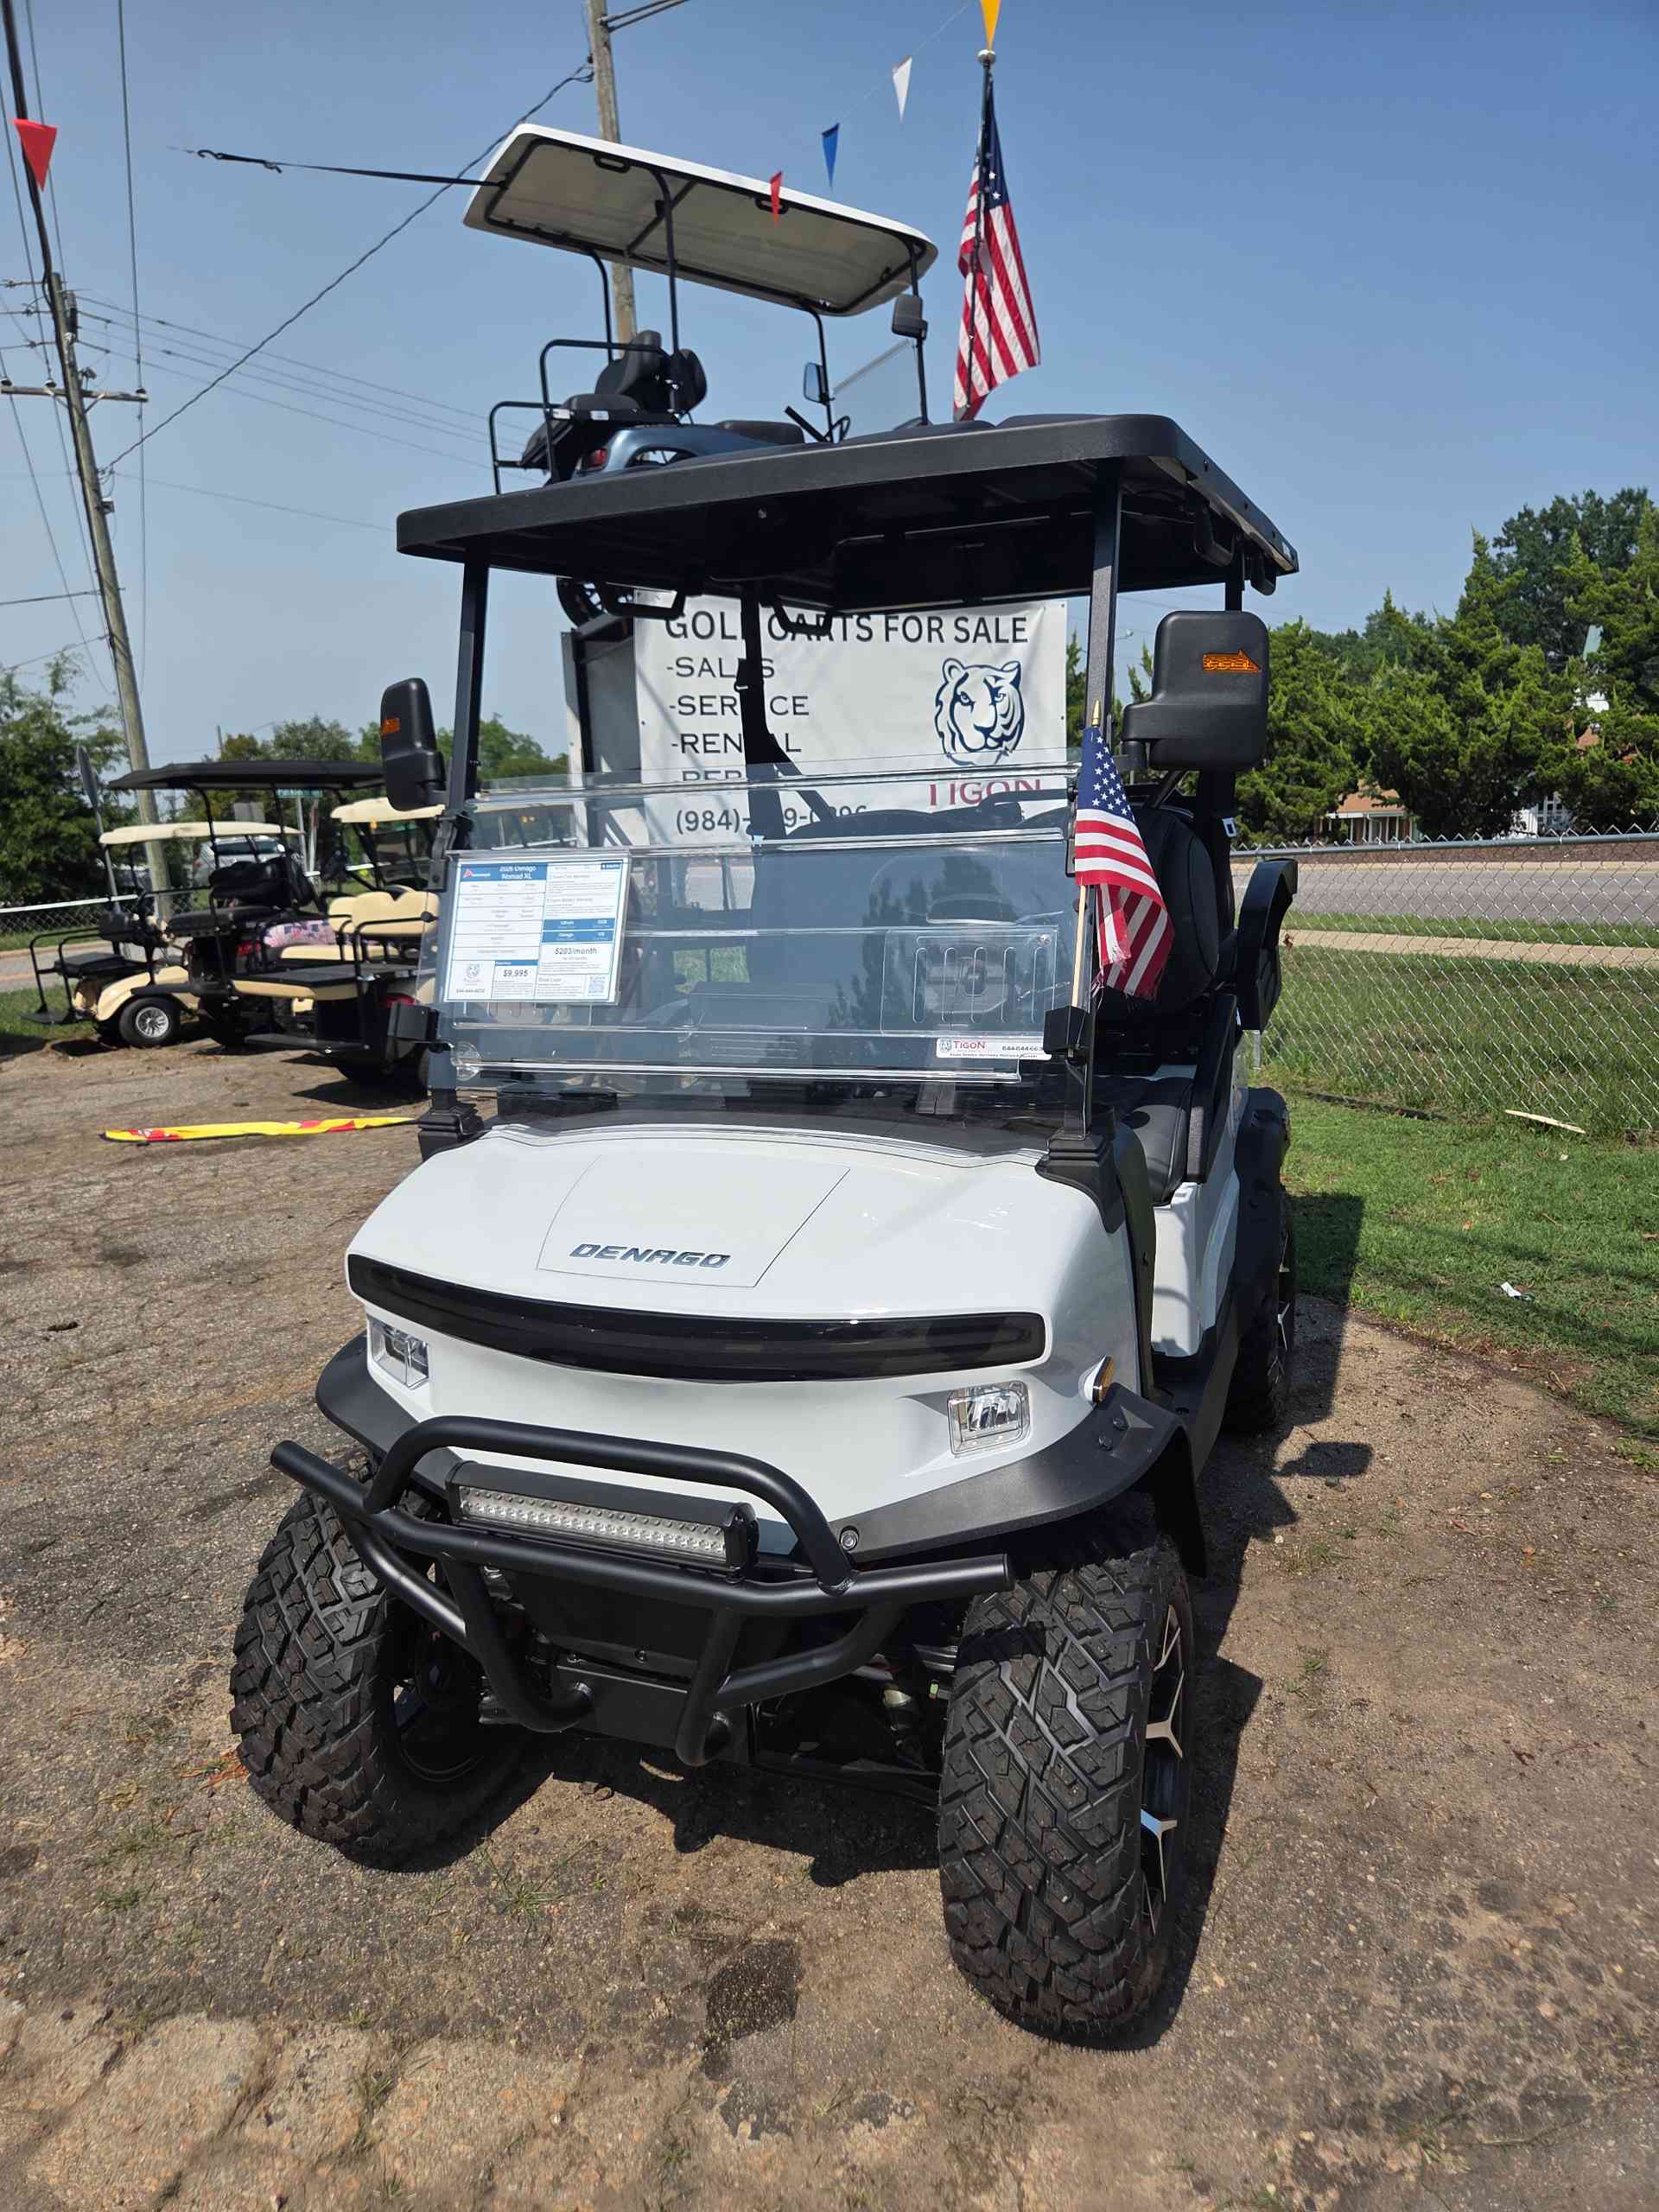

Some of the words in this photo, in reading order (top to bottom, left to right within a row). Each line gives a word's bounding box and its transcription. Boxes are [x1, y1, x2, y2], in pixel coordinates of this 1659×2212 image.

[665, 611, 746, 640] GOL
[885, 615, 944, 643] FOR
[954, 616, 1028, 644] SALE
[667, 657, 775, 678] -SALS
[669, 695, 810, 715] -SERCE
[671, 733, 802, 753] -RENL
[569, 1243, 732, 1268] DENAGO
